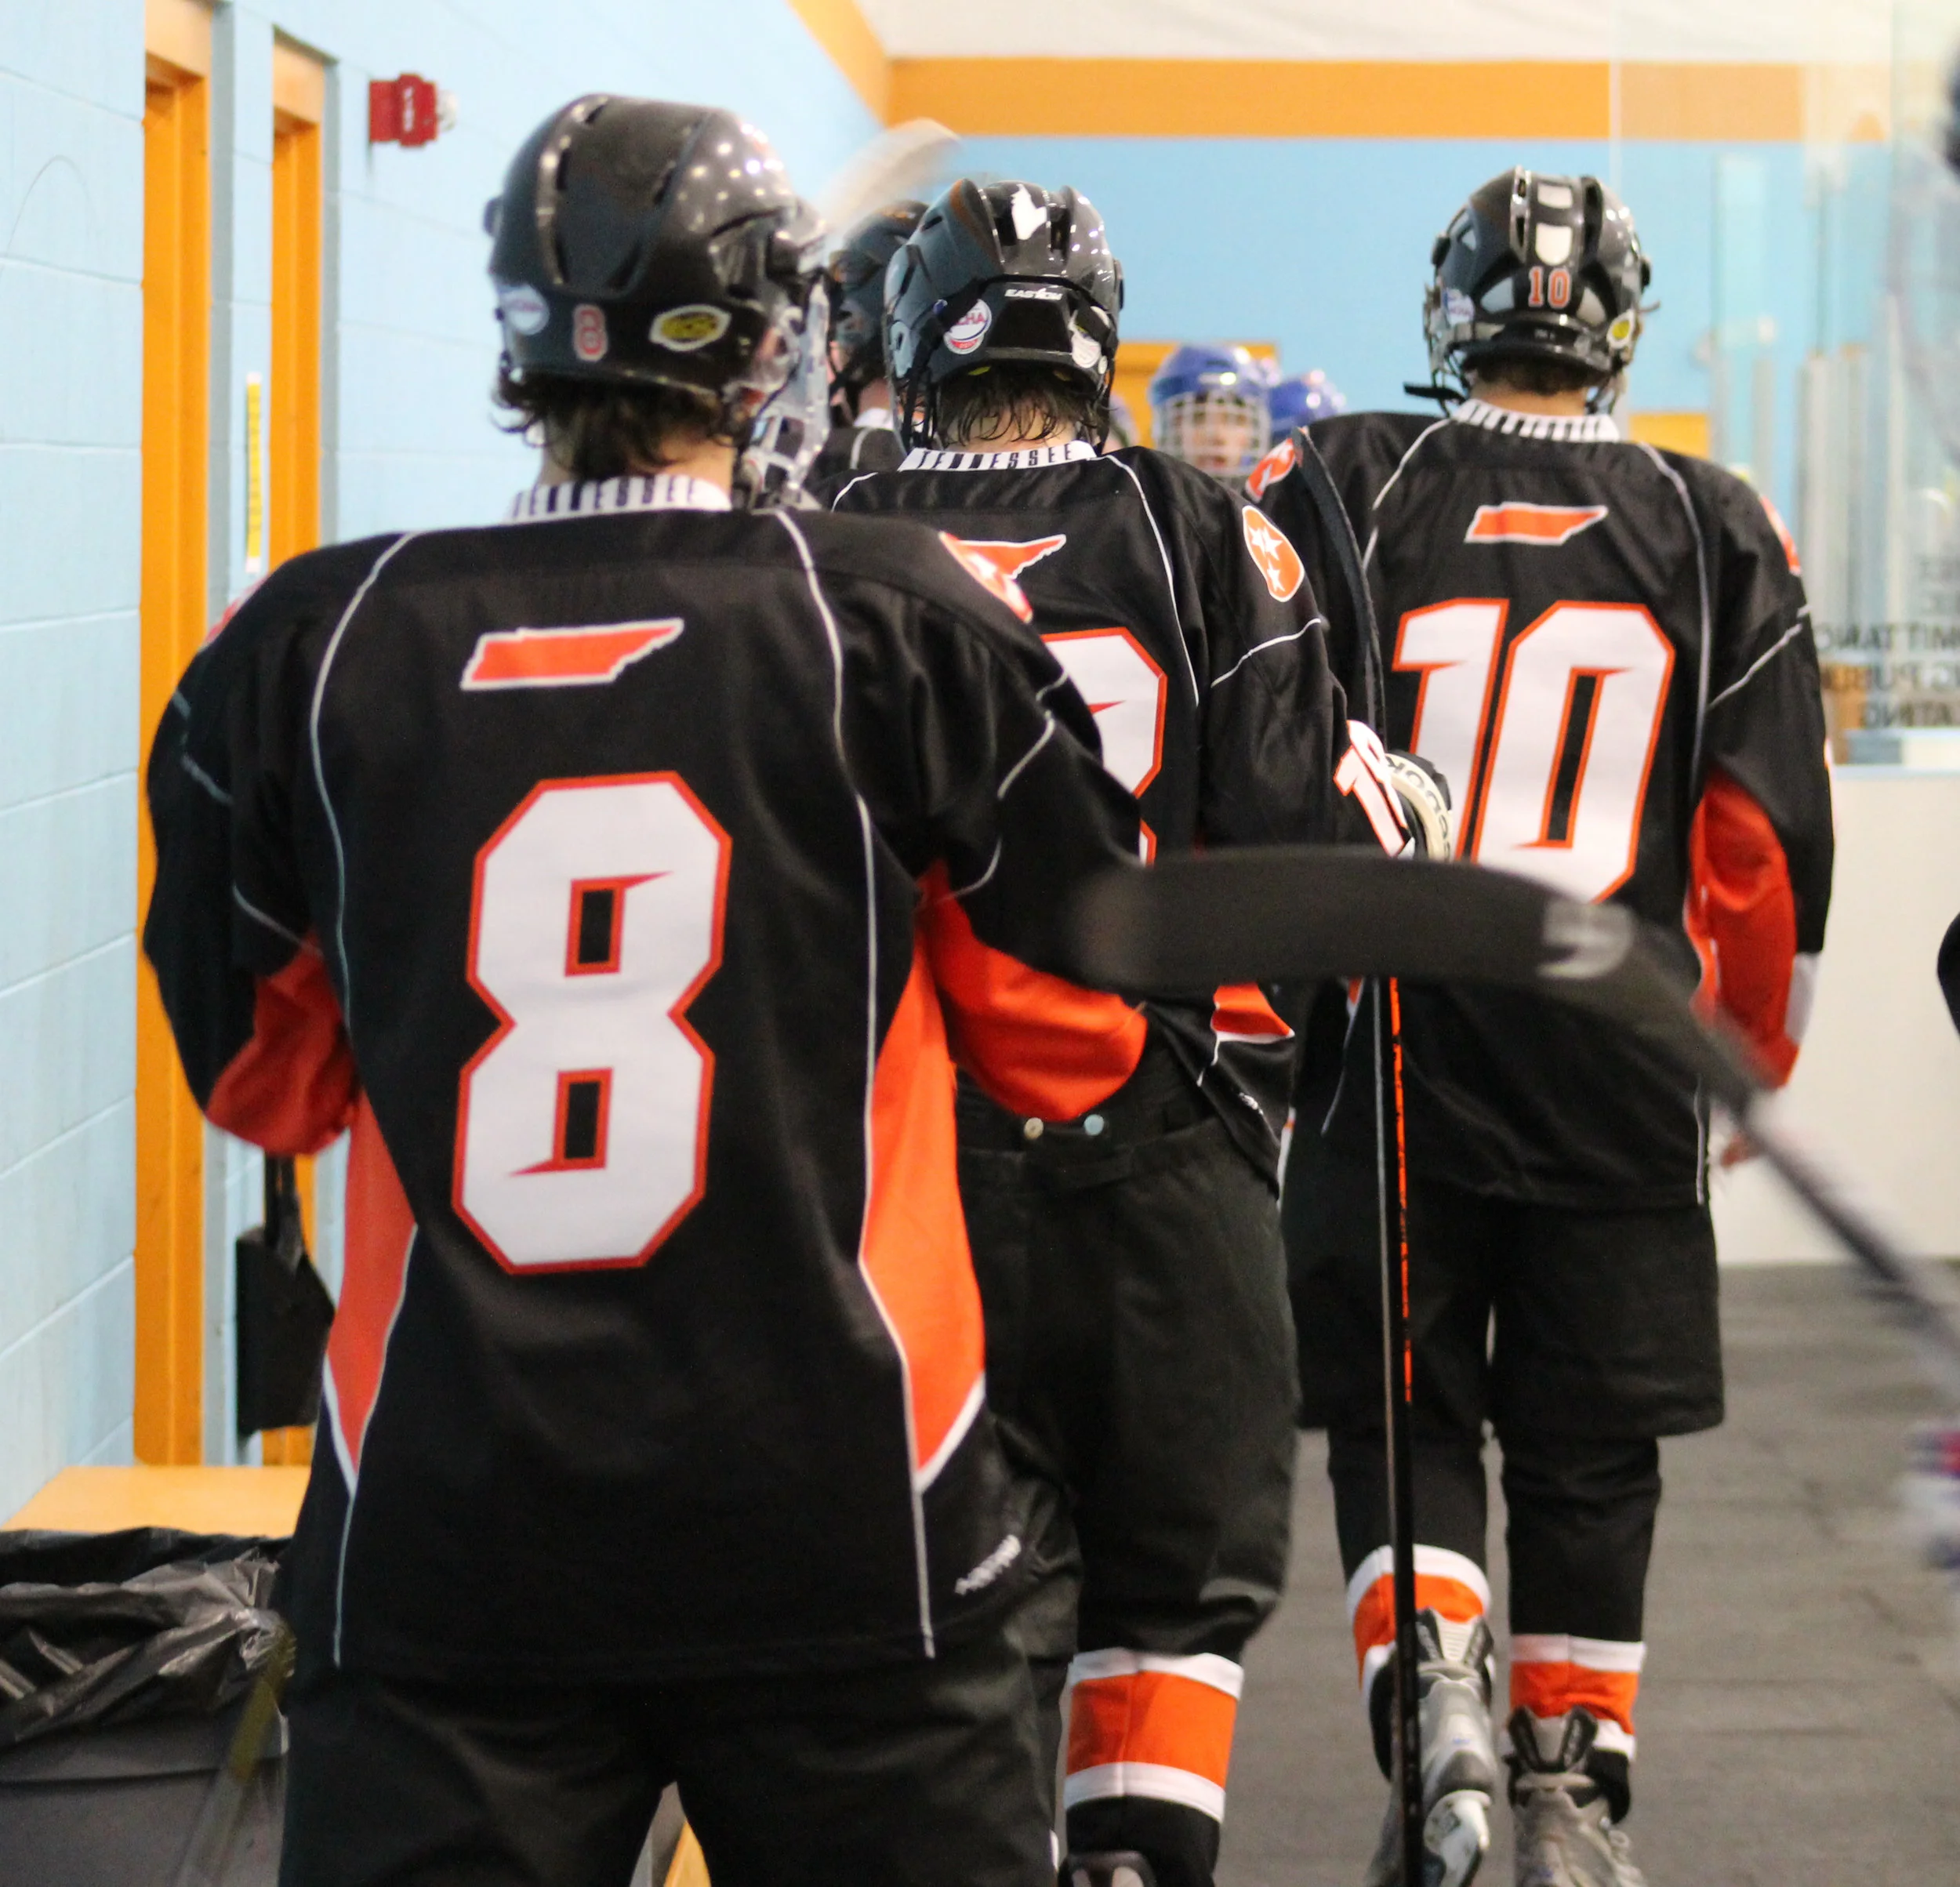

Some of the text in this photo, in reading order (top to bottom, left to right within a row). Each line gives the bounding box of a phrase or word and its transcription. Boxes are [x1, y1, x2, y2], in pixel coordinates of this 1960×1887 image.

[1004, 288, 1063, 300] EASTON
[1529, 266, 1572, 309] 10
[573, 304, 608, 361] 8
[916, 443, 1073, 470] TENNESSEE
[1392, 597, 1675, 905] 10
[452, 771, 732, 1274] 8
